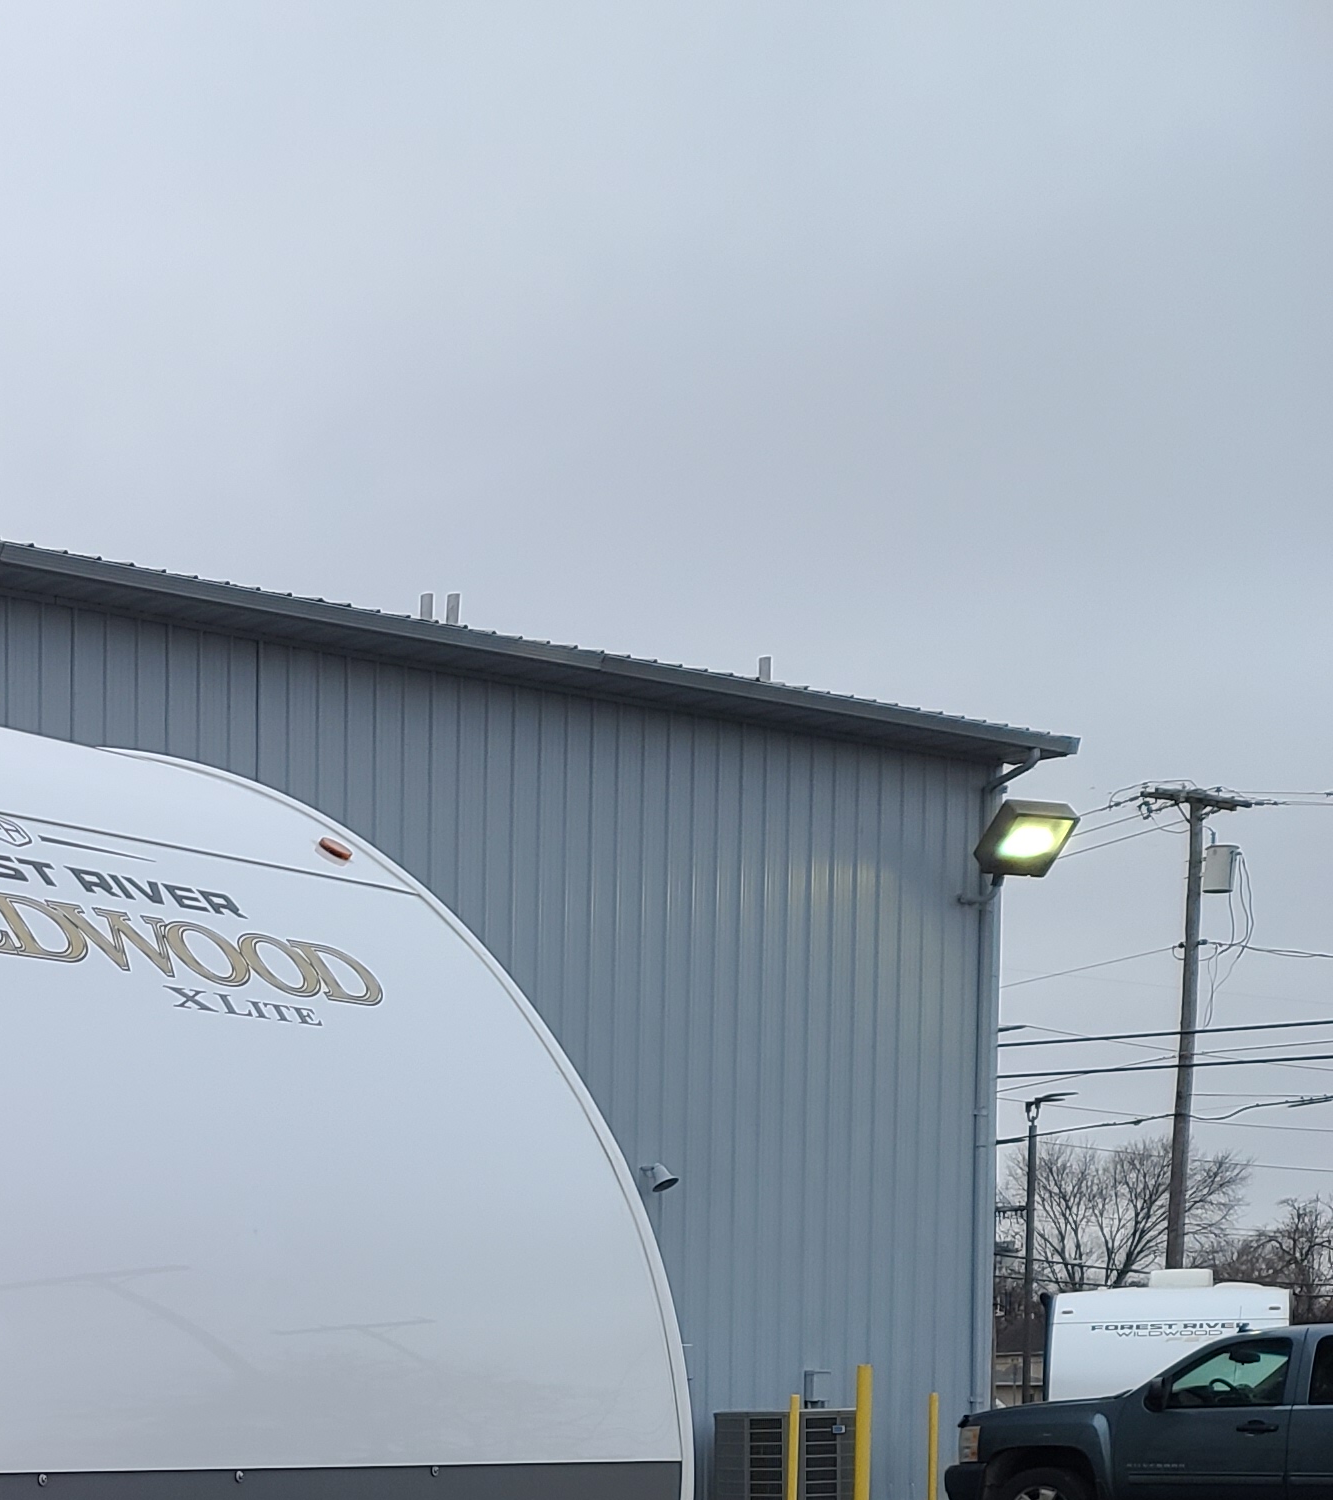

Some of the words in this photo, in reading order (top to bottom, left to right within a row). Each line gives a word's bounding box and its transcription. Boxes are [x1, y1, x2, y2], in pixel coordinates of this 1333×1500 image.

[62, 865, 248, 919] RIVER
[162, 984, 220, 1014] X
[213, 991, 323, 1027] LITE
[1091, 1322, 1178, 1331] FOREST
[1116, 1329, 1223, 1338] WILDWOOD
